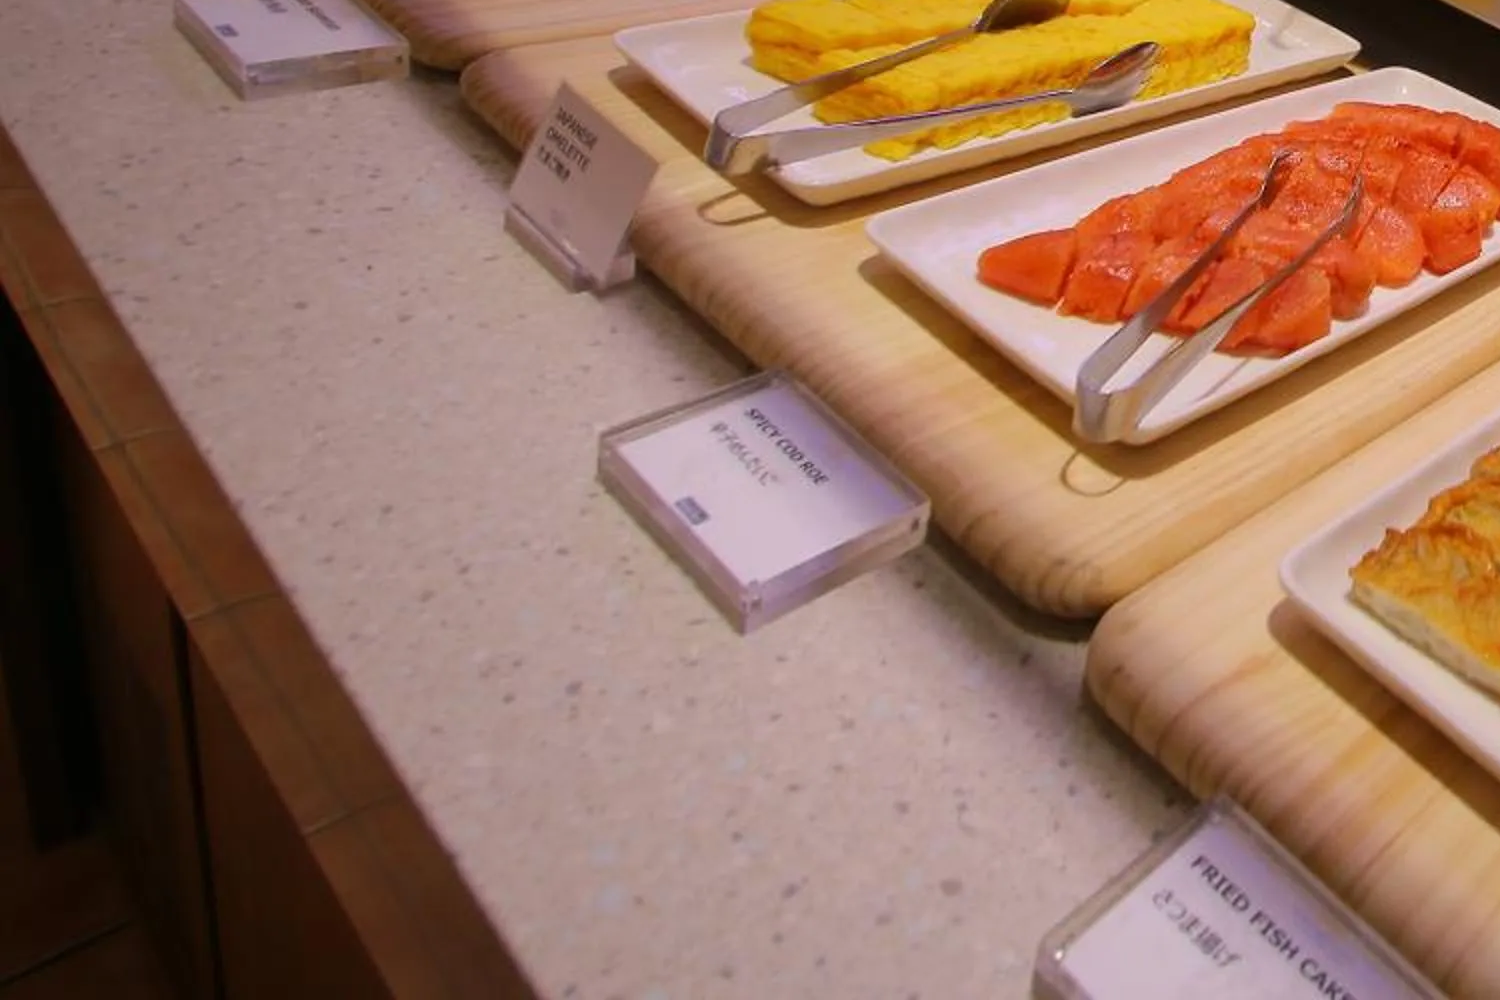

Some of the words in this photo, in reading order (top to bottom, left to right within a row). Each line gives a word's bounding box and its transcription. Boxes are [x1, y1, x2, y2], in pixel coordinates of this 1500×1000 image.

[546, 126, 592, 173] OMELETTE
[744, 407, 783, 439] SPICY
[775, 437, 805, 463] COD
[799, 460, 831, 486] ROE
[1190, 854, 1250, 914] FRIED
[1249, 909, 1300, 961] FISH
